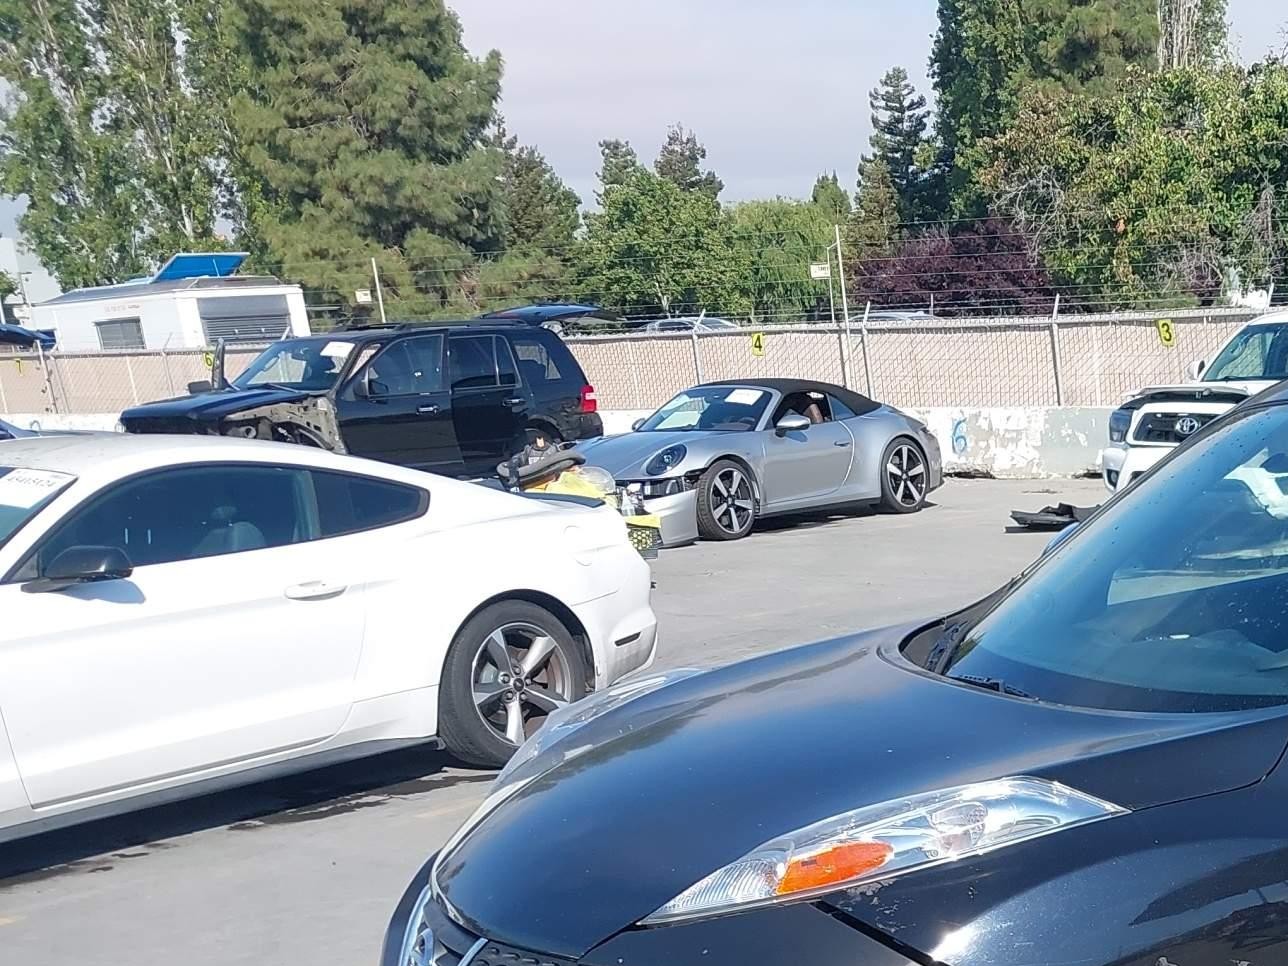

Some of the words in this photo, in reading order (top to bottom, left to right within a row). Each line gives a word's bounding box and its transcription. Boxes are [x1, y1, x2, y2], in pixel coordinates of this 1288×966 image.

[1161, 322, 1172, 342] 3
[754, 334, 763, 352] 4
[951, 417, 968, 455] 6
